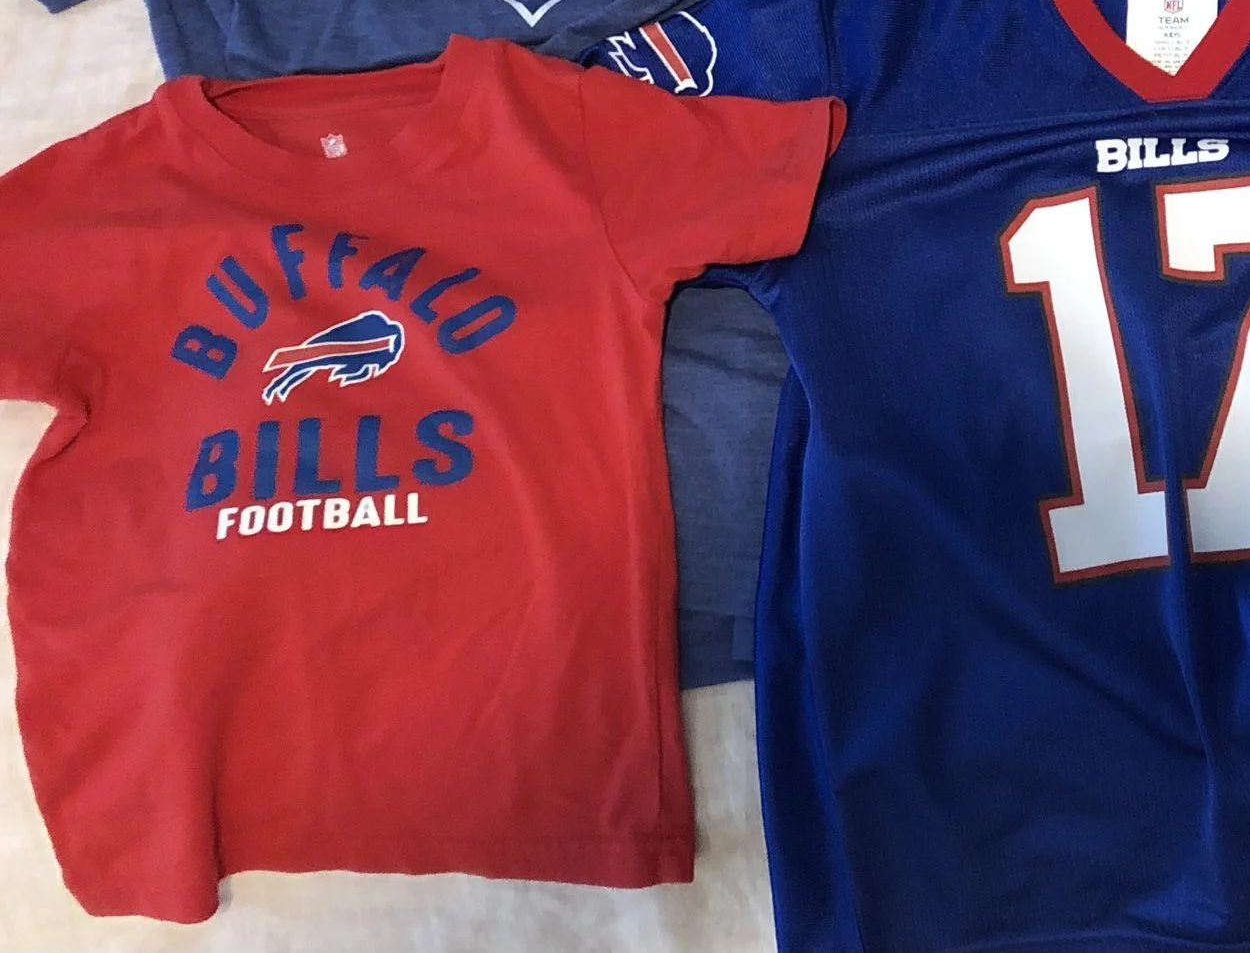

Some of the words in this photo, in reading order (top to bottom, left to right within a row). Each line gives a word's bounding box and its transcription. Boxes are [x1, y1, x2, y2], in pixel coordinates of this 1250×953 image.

[1158, 16, 1189, 25] TEAM
[1166, 0, 1183, 10] NFL
[1095, 137, 1230, 173] BILLS
[170, 223, 518, 380] BUFFALO
[185, 409, 475, 512] BILLS
[216, 492, 428, 540] FOOTBALL
